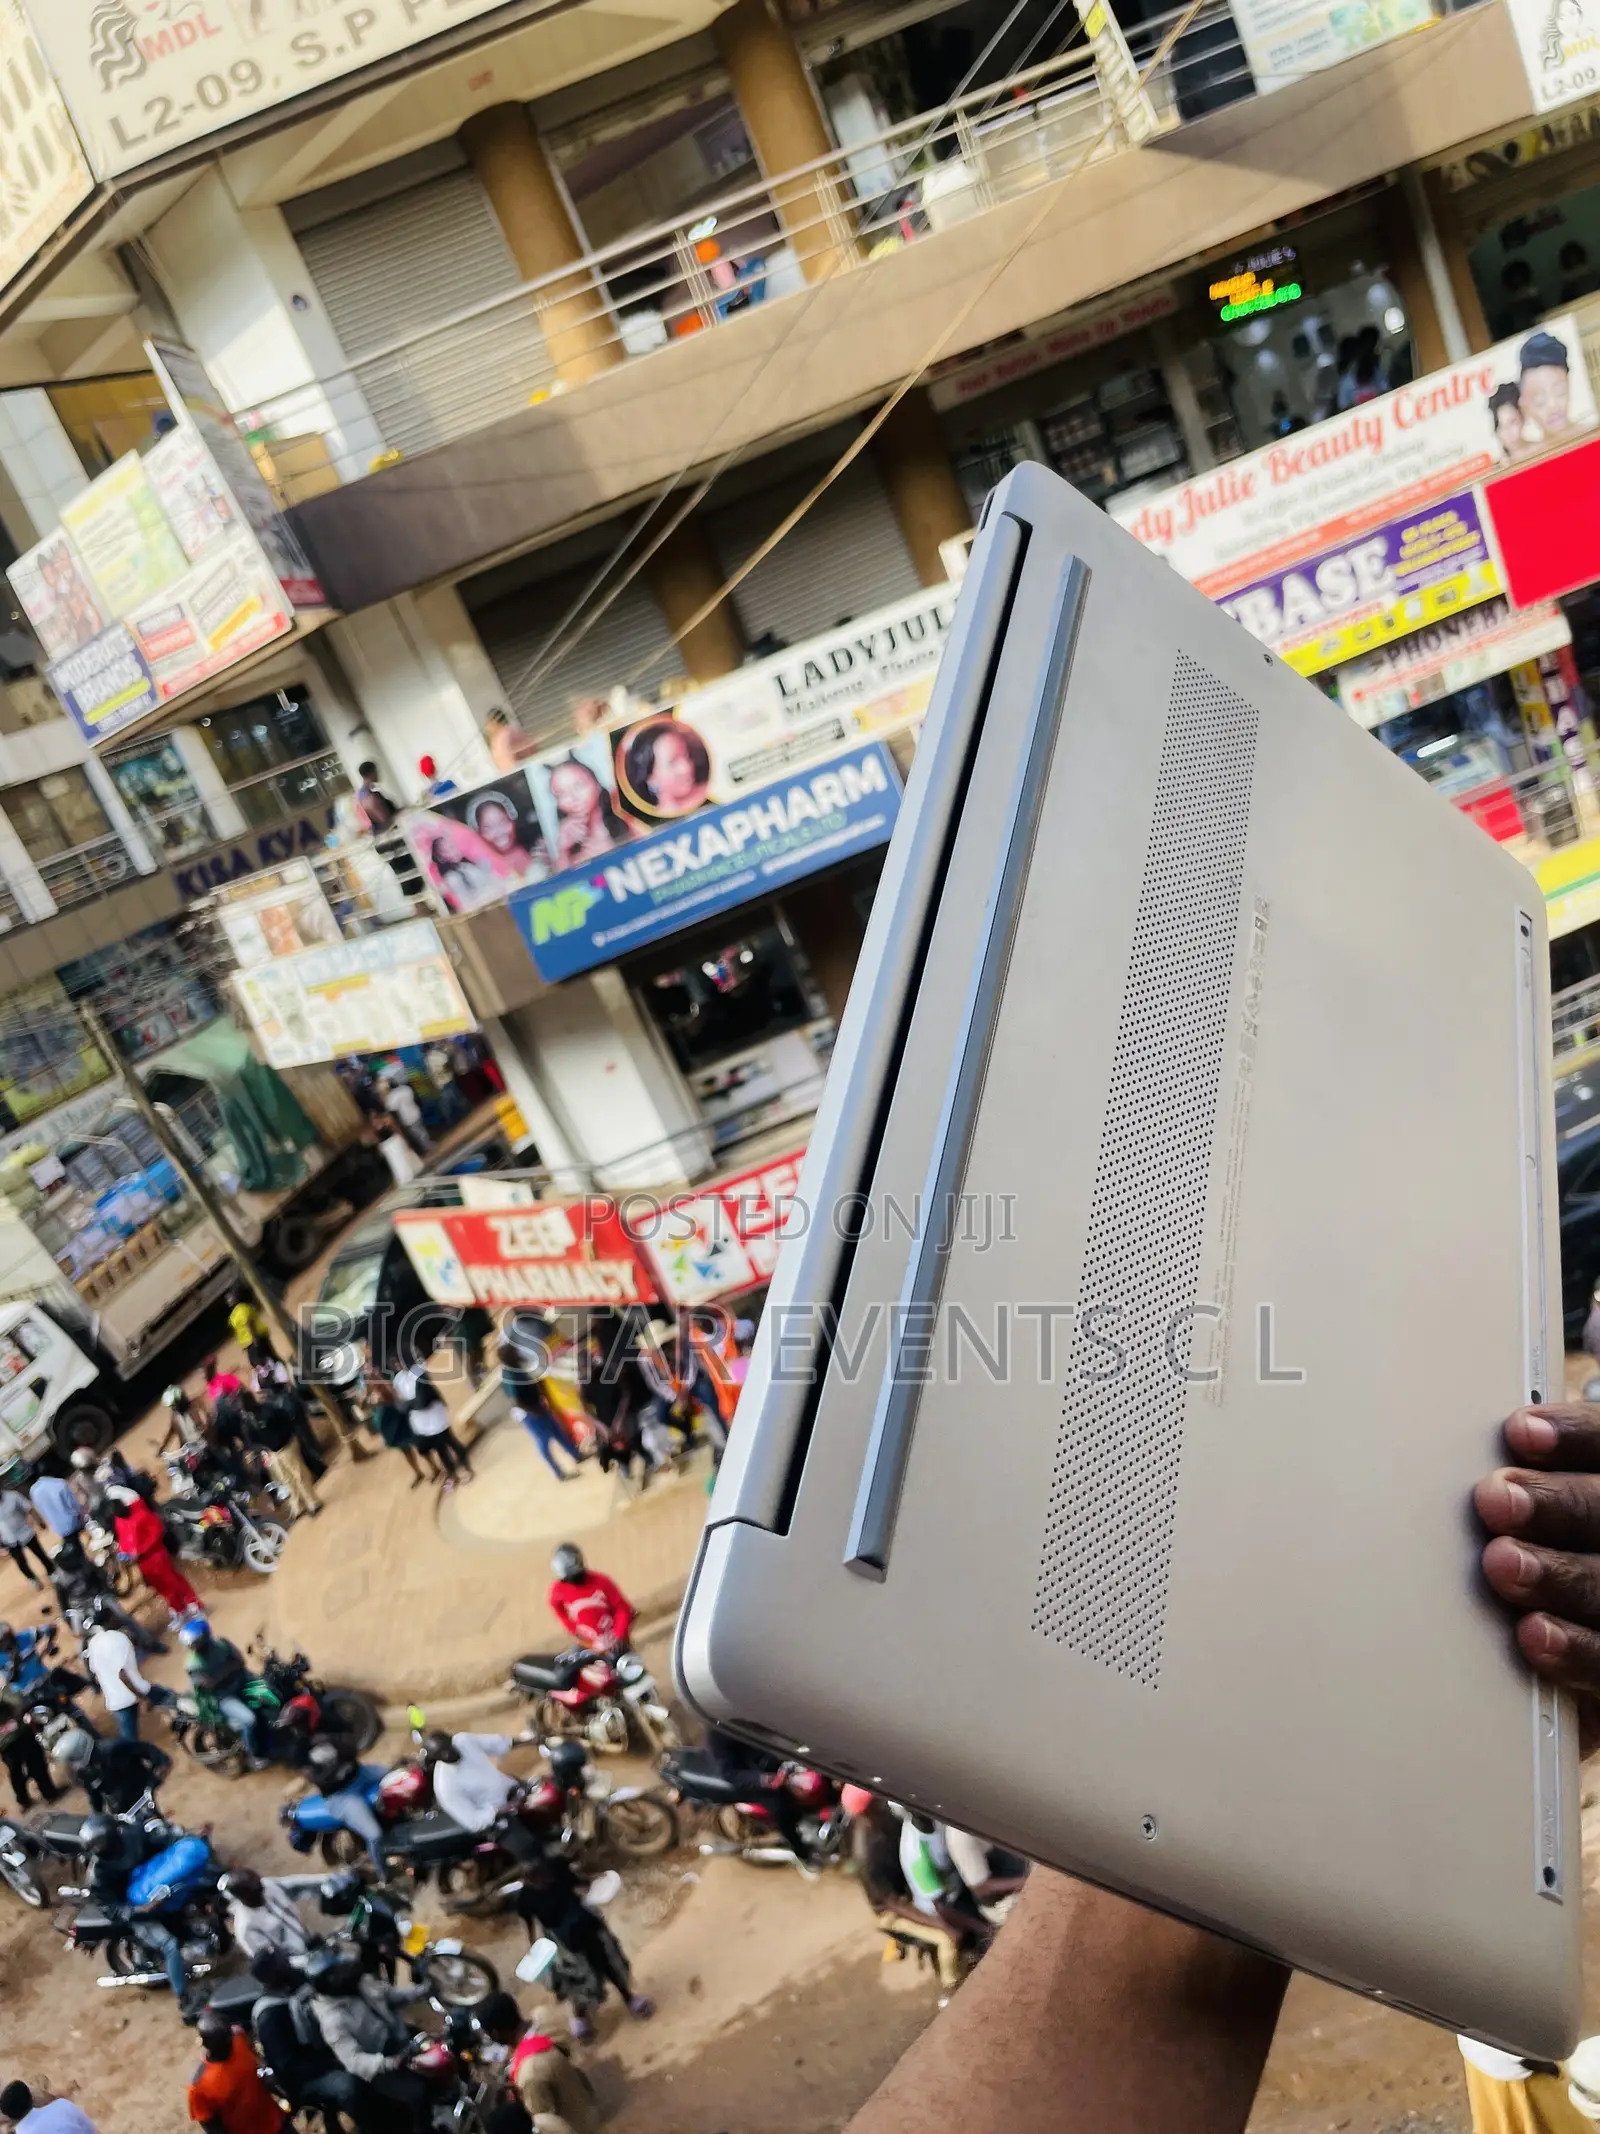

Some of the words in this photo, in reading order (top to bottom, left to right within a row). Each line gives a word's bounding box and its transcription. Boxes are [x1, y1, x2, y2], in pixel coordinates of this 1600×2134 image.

[142, 13, 222, 64] MDL
[290, 8, 376, 67] S.P
[1176, 466, 1259, 537] Julie
[1265, 414, 1384, 487] Beauty
[1393, 363, 1497, 432] Centre
[1222, 536, 1400, 638] BASE
[773, 598, 958, 698] LADYJUL
[605, 754, 889, 902] NEXAPHARM
[738, 1160, 808, 1232] ZE
[490, 1206, 577, 1259] ZEE
[467, 1259, 643, 1302] PHARMACY
